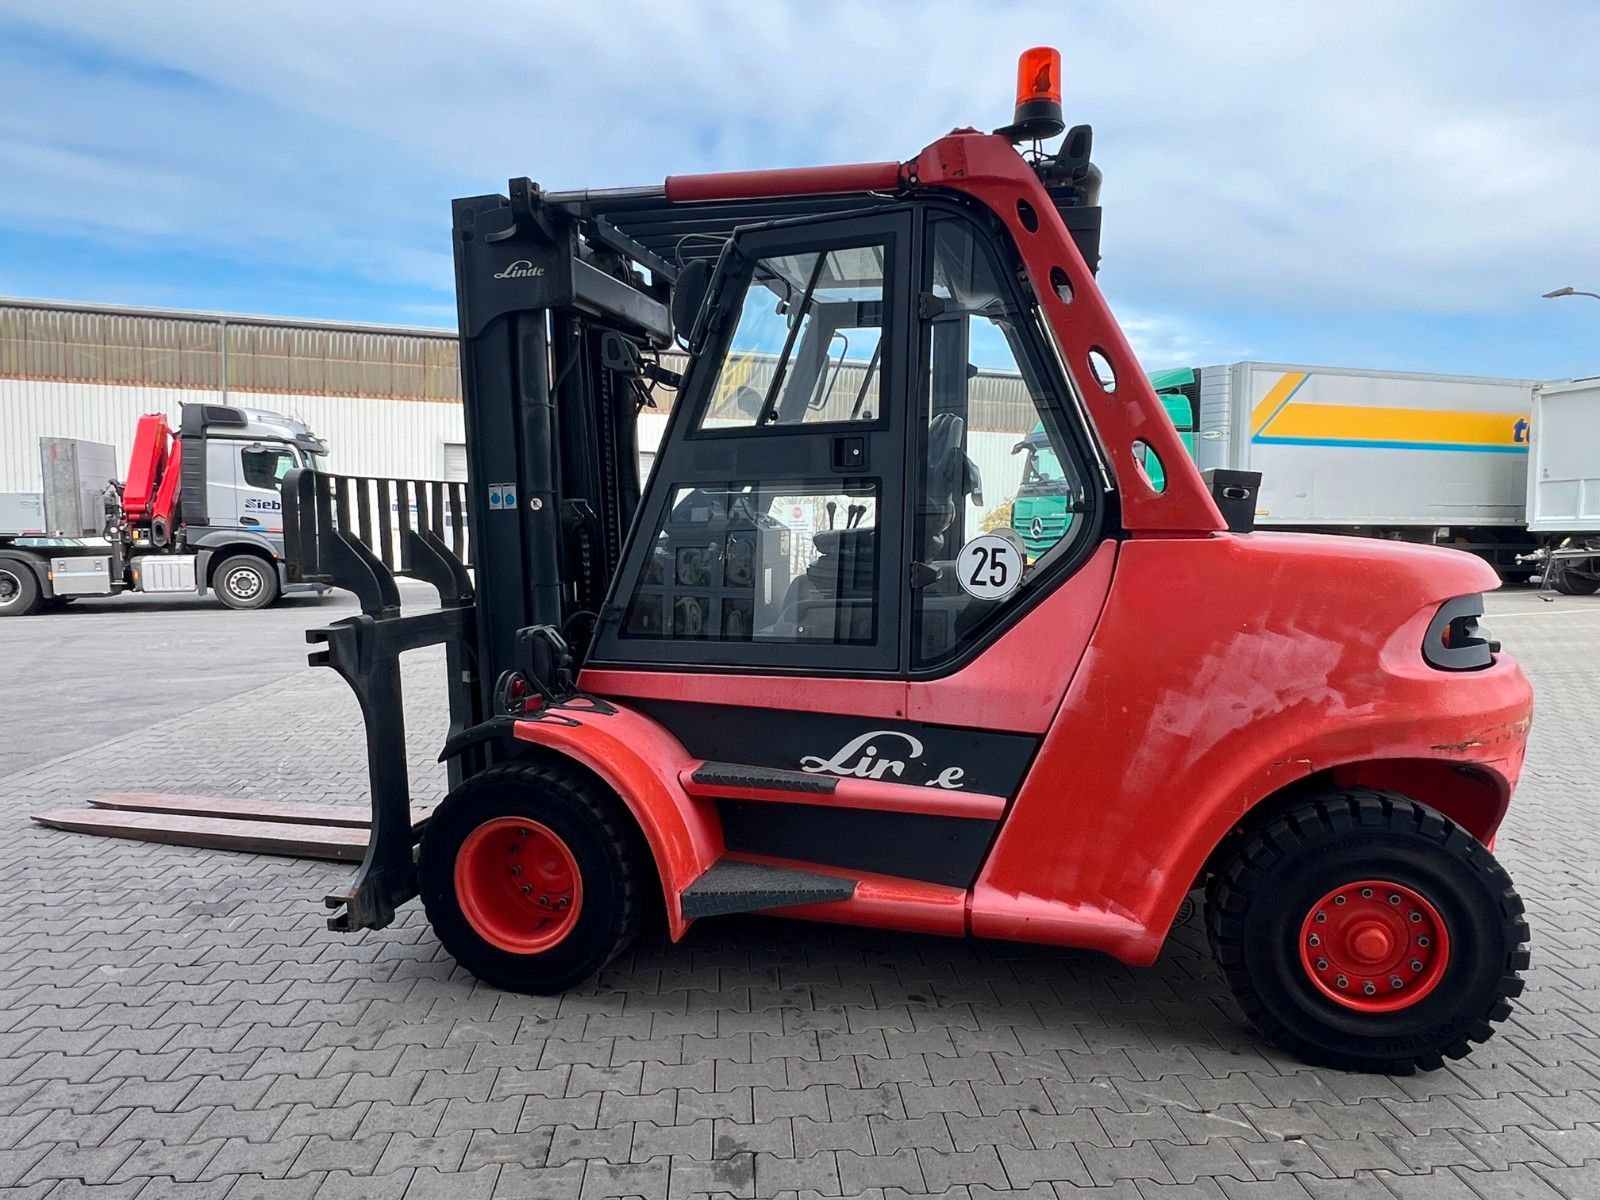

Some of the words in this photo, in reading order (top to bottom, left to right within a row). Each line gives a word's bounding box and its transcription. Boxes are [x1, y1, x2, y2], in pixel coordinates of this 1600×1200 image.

[493, 259, 545, 279] Linde
[1514, 418, 1530, 443] t
[245, 498, 281, 513] Sieb
[970, 548, 1007, 587] 25
[800, 731, 964, 789] Line
